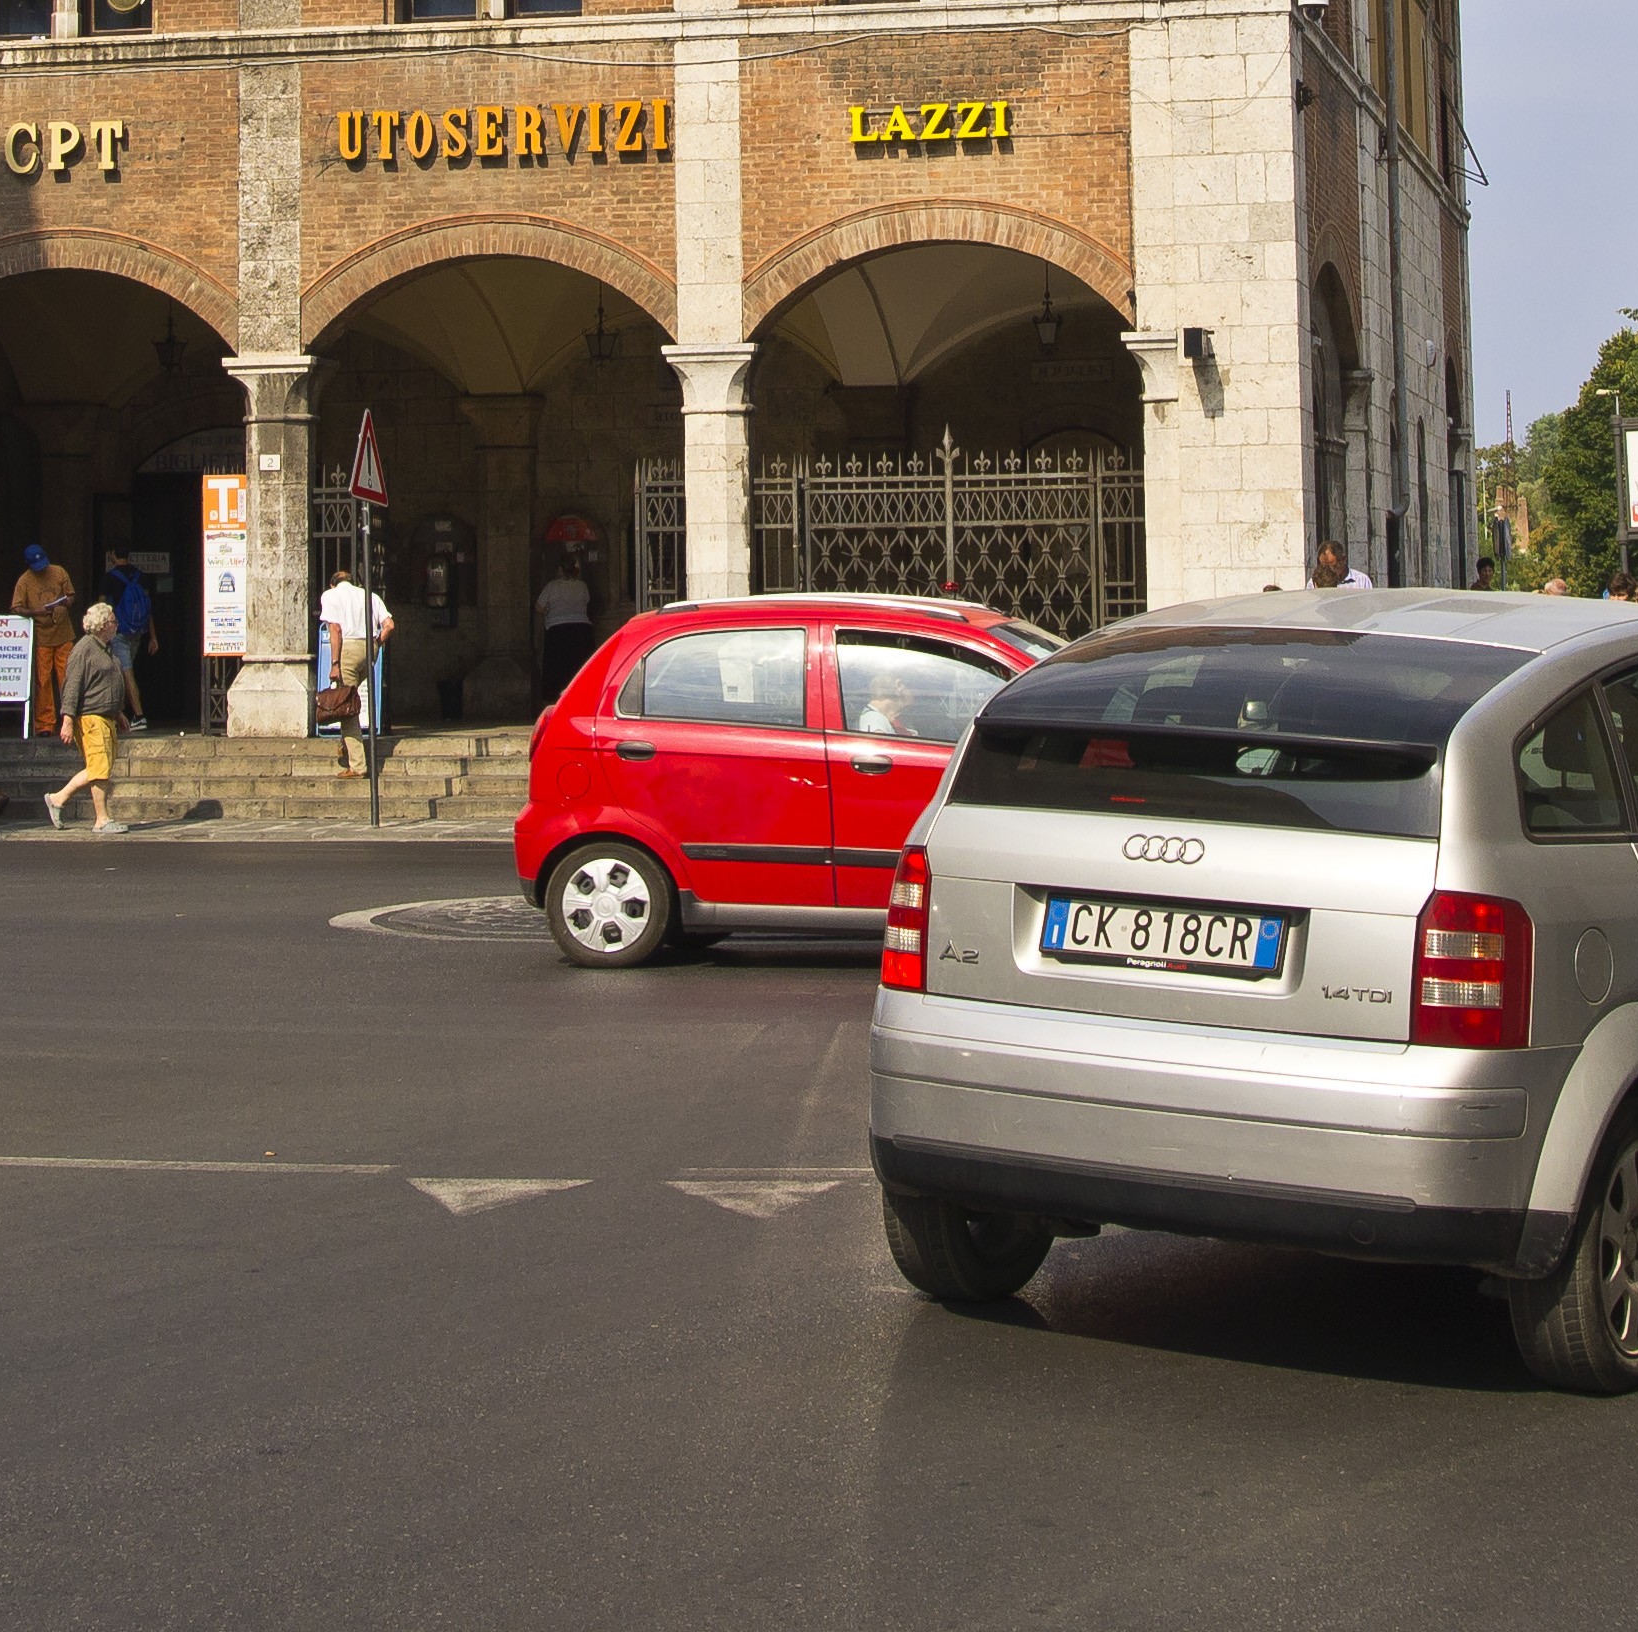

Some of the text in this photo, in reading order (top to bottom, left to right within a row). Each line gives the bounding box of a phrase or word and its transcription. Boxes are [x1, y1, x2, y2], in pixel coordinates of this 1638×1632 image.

[337, 99, 667, 160] UTOSERVIZI
[848, 101, 1009, 143] LAZZI
[5, 120, 123, 174] CPT
[267, 457, 274, 468] 2
[939, 939, 979, 965] A2
[1071, 904, 1119, 948] CK
[1130, 909, 1253, 961] 818CR
